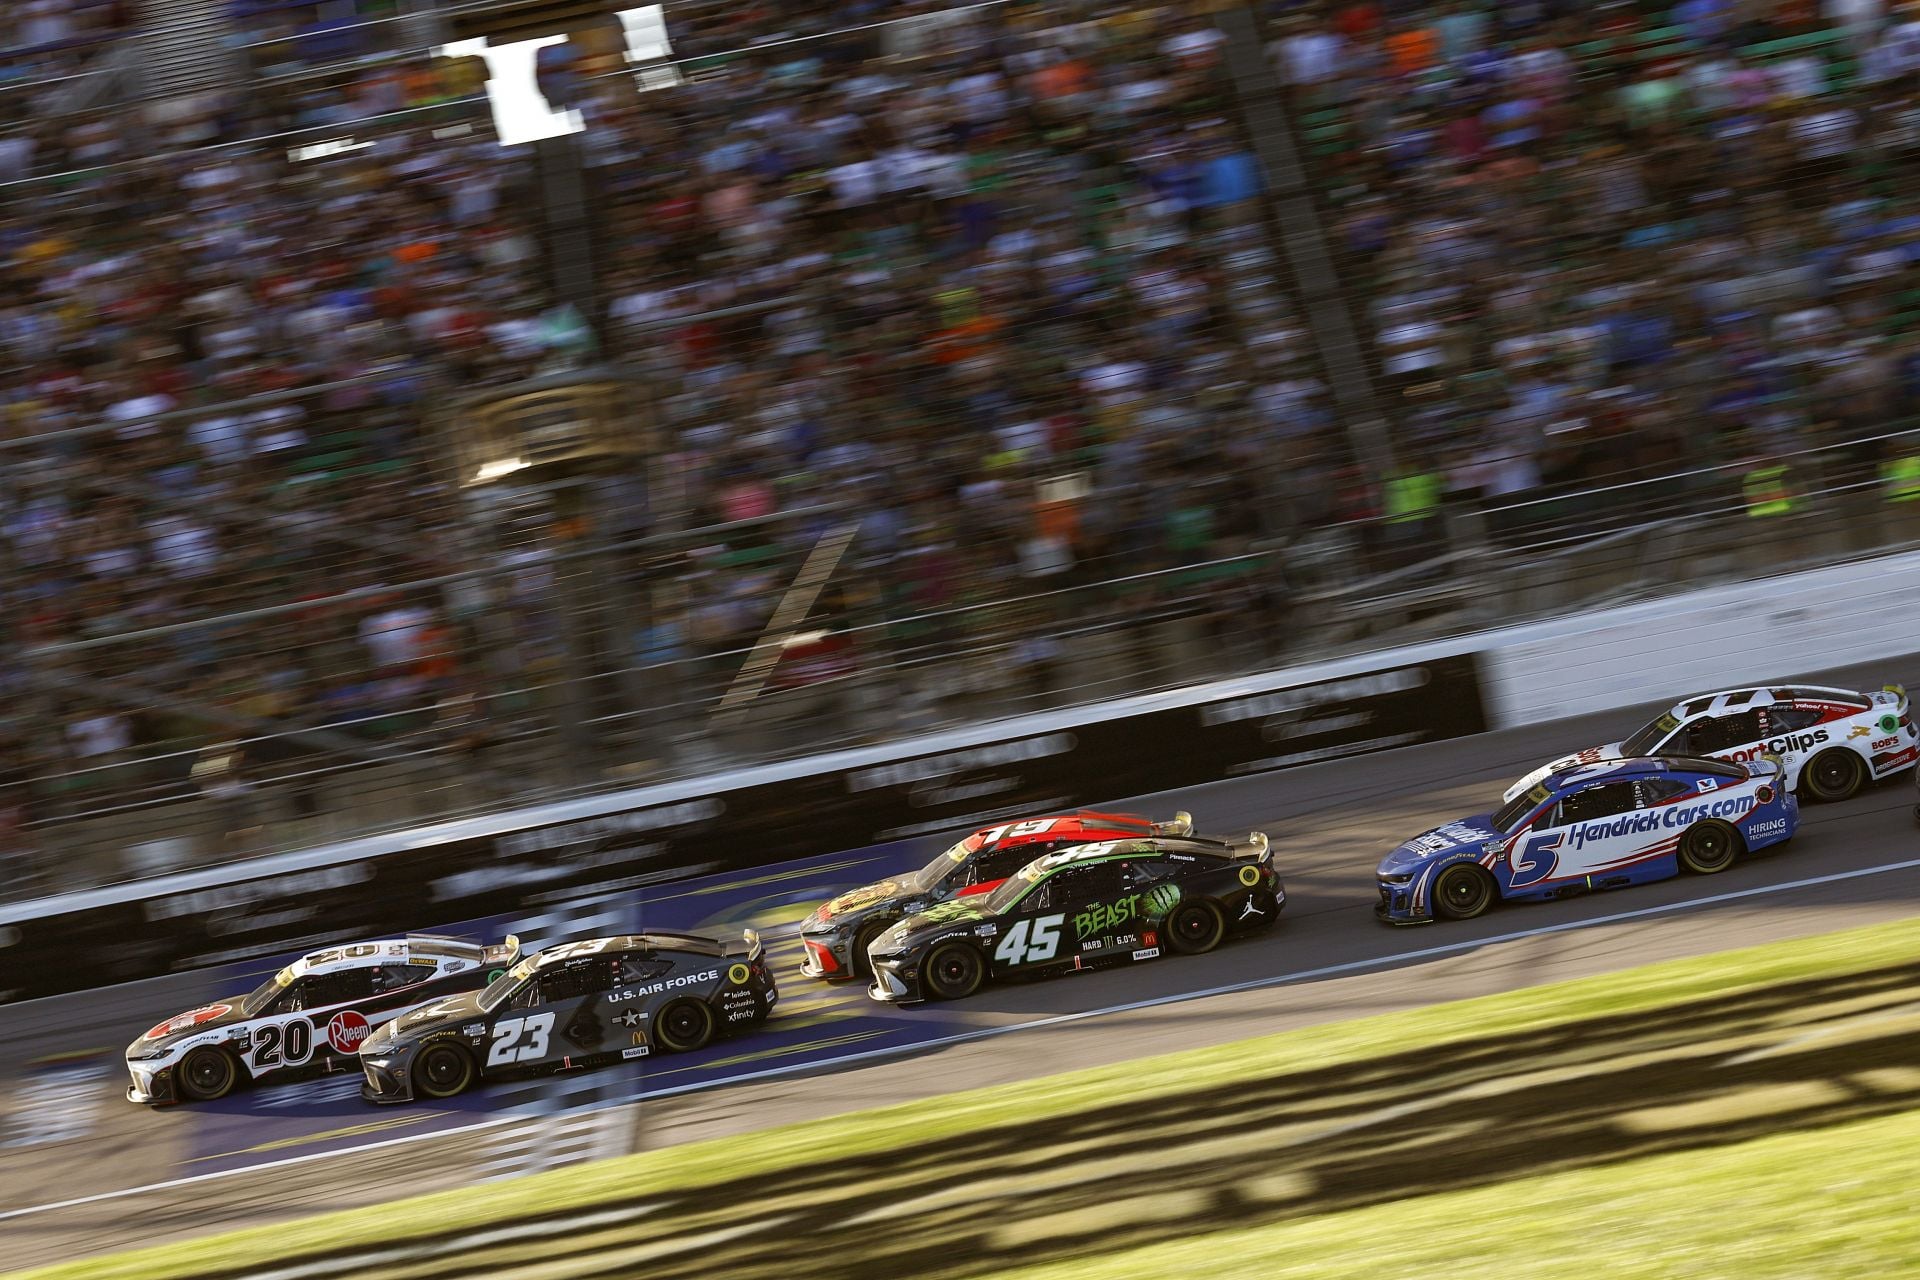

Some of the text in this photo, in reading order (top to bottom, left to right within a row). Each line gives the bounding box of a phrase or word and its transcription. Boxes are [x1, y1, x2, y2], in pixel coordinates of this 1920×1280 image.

[1871, 736, 1899, 750] BOB'S
[1875, 752, 1911, 773] PROGRESSIVE
[983, 818, 1060, 845] 19
[1749, 818, 1786, 835] HIRING
[1749, 827, 1786, 841] TECHNICIANS
[1042, 839, 1125, 867] 45
[1169, 853, 1196, 862] Pinnacle
[1510, 832, 1567, 888] 5
[1072, 893, 1141, 942] BEAST
[1085, 902, 1101, 912] THE
[994, 913, 1065, 966] 45
[1082, 934, 1137, 951] HARD 6.0%
[305, 944, 380, 968] 20
[608, 969, 719, 1003] U.S. AIR FORCE
[731, 990, 751, 999] leidos
[729, 998, 755, 1010] Columbia
[728, 1009, 755, 1022] xfinity
[331, 1012, 369, 1047] Rheem
[487, 1011, 556, 1067] 23
[252, 1016, 318, 1069] 20
[624, 1049, 641, 1057] Mobil
